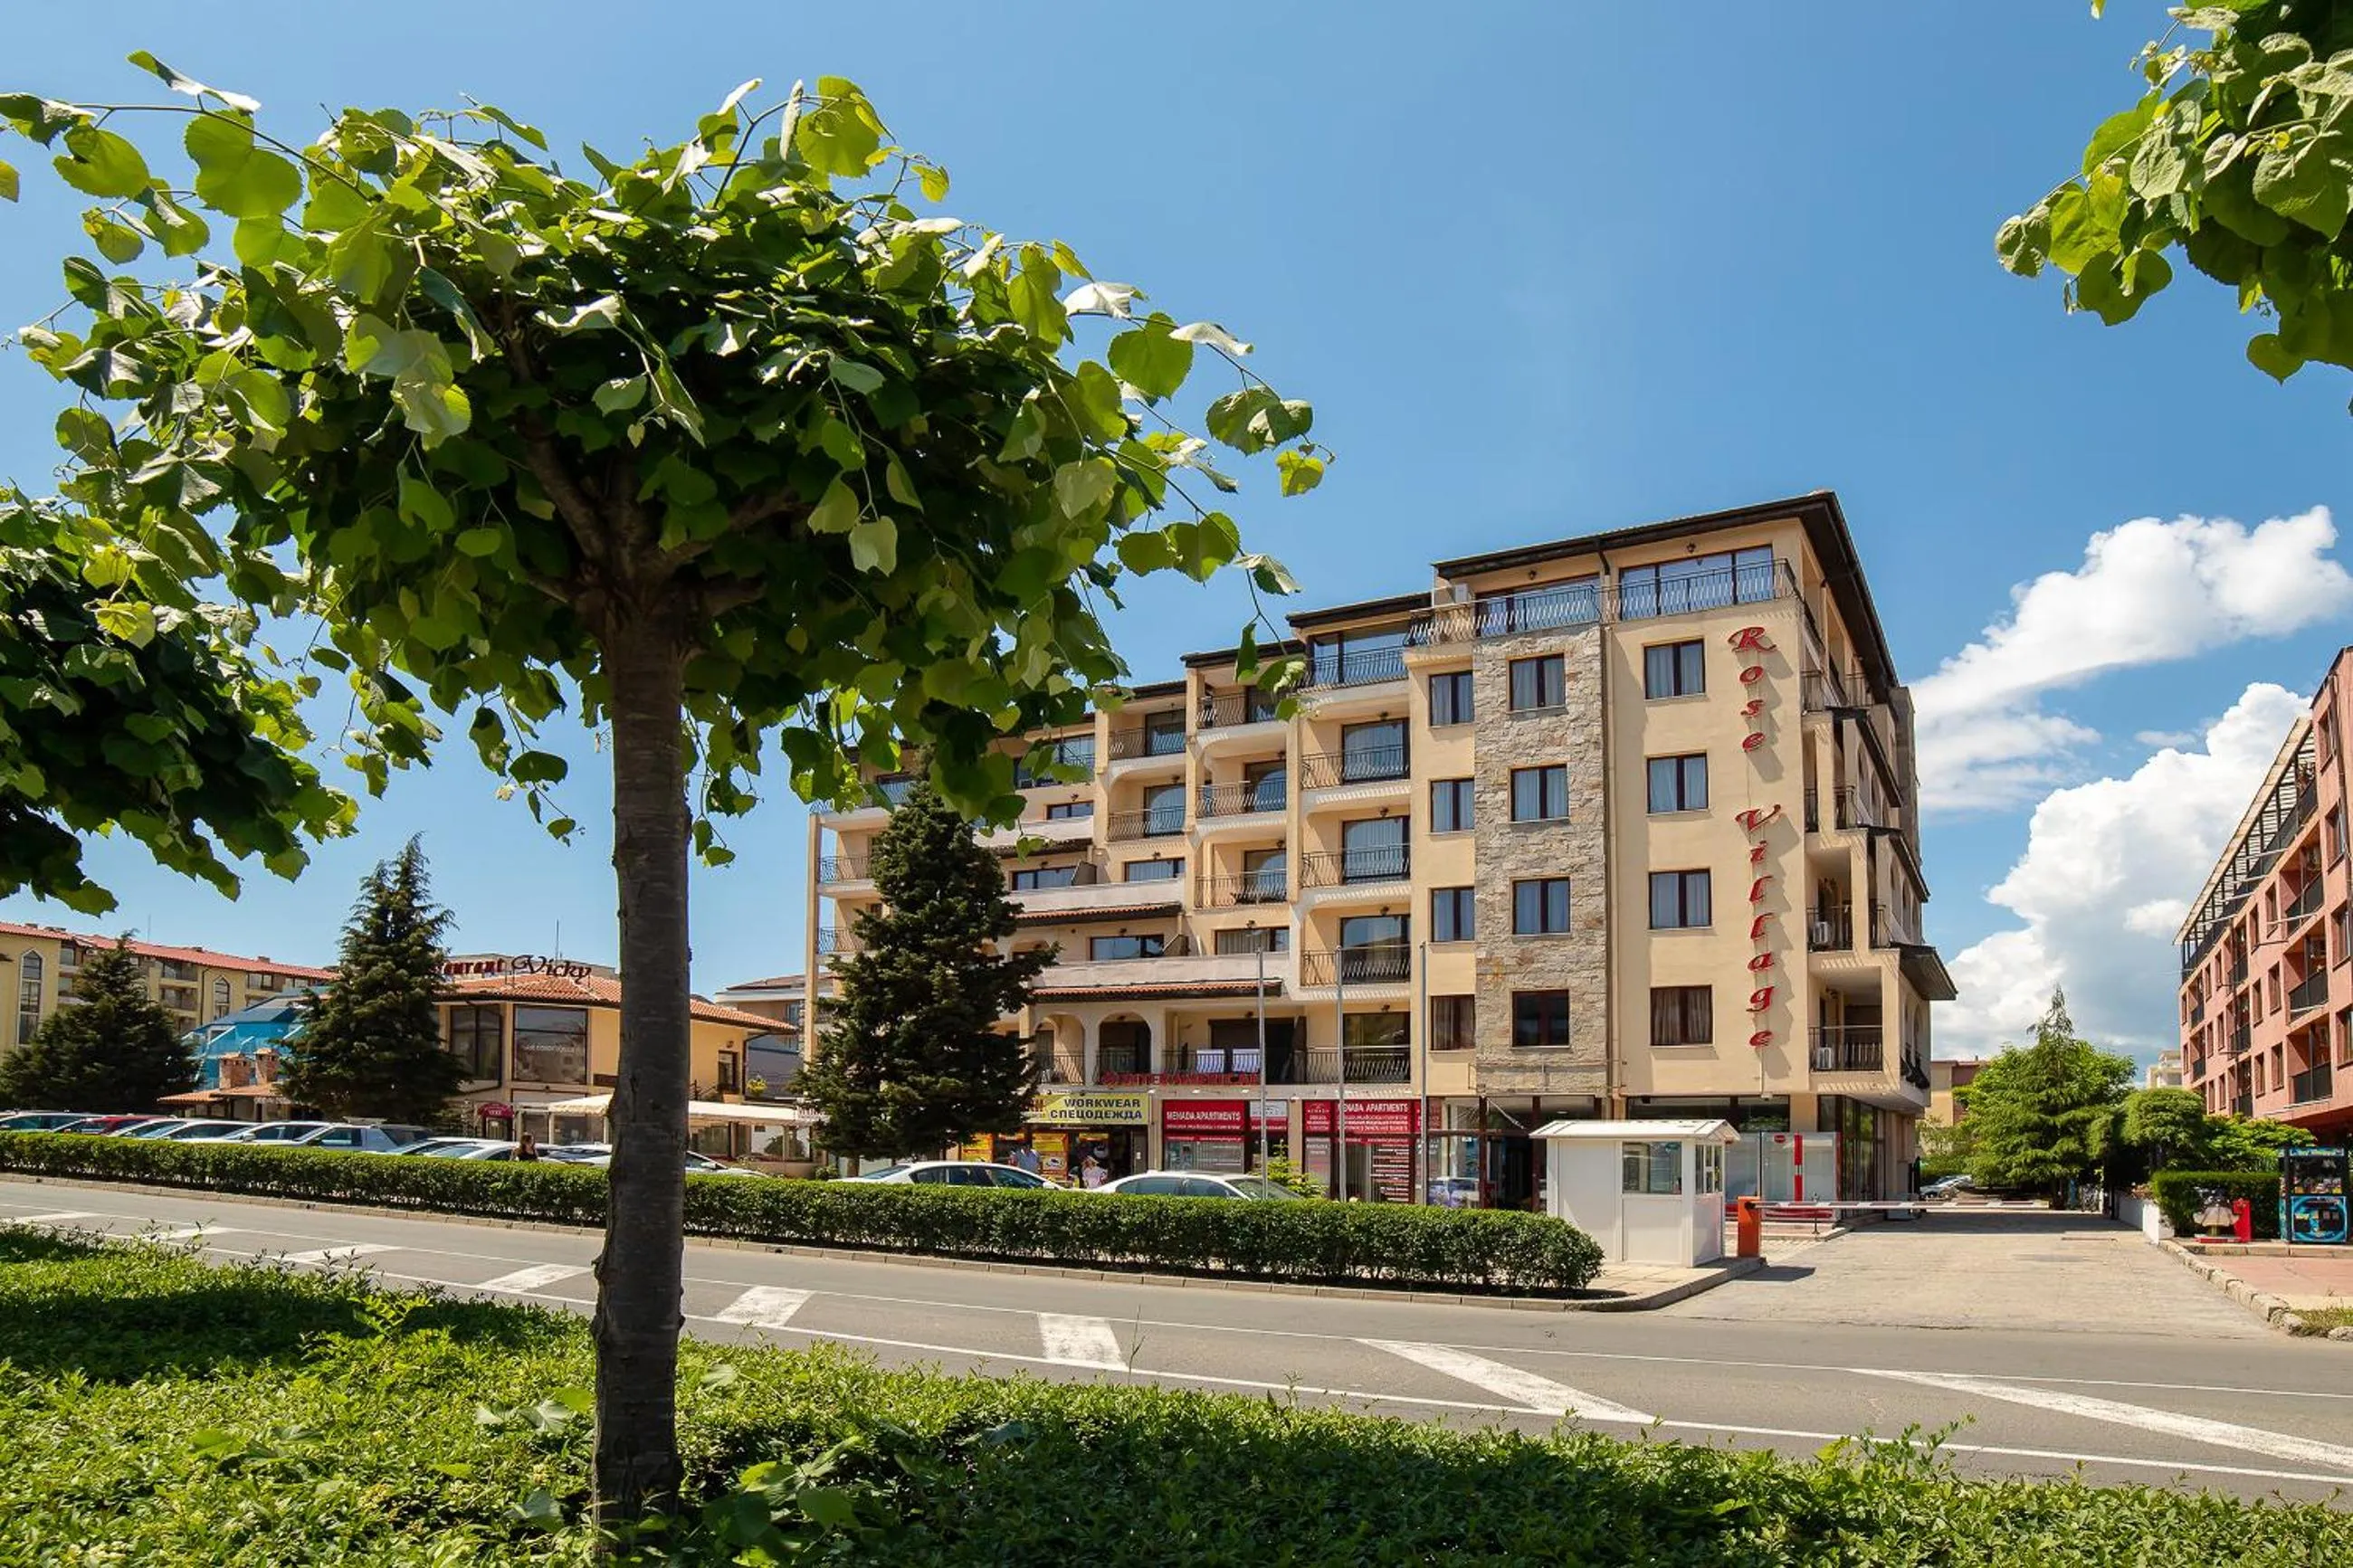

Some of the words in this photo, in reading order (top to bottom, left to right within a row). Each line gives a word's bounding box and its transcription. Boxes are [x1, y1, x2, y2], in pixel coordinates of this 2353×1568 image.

[1728, 626, 1777, 752] Rose
[1734, 804, 1781, 1048] Village
[511, 955, 591, 984] Vicky
[1064, 1098, 1140, 1108] WORKWEAR
[1366, 1103, 1408, 1113] APARTMENTS
[1050, 1109, 1143, 1120] СПЕЦОДЕЖДА
[1196, 1111, 1241, 1121] APARTMENTS
